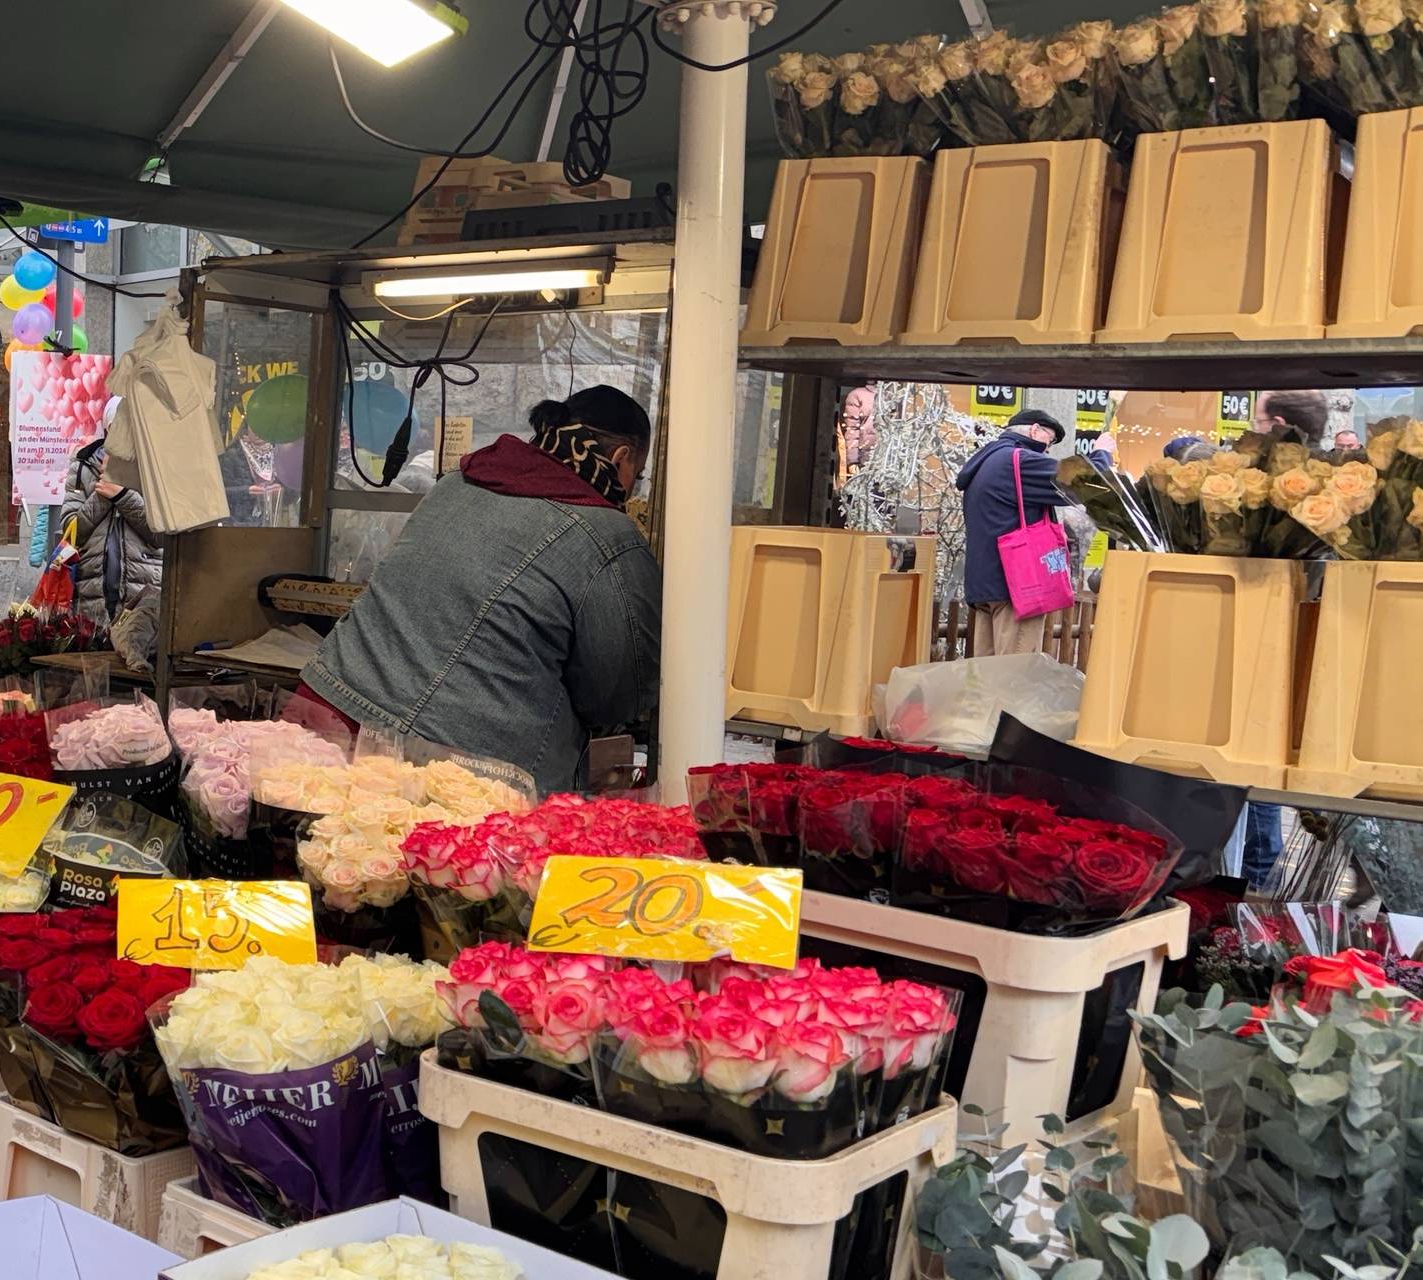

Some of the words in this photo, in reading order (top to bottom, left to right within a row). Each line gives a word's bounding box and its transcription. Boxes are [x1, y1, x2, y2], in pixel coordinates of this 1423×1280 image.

[978, 385, 1014, 400] 50€
[1077, 388, 1108, 406] 50€
[1222, 395, 1249, 414] 50€
[19, 425, 61, 433] Blumenstand
[27, 456, 45, 464] Jahre
[125, 776, 152, 787] VAN
[62, 868, 103, 888] Rosa
[59, 880, 106, 902] Plaza
